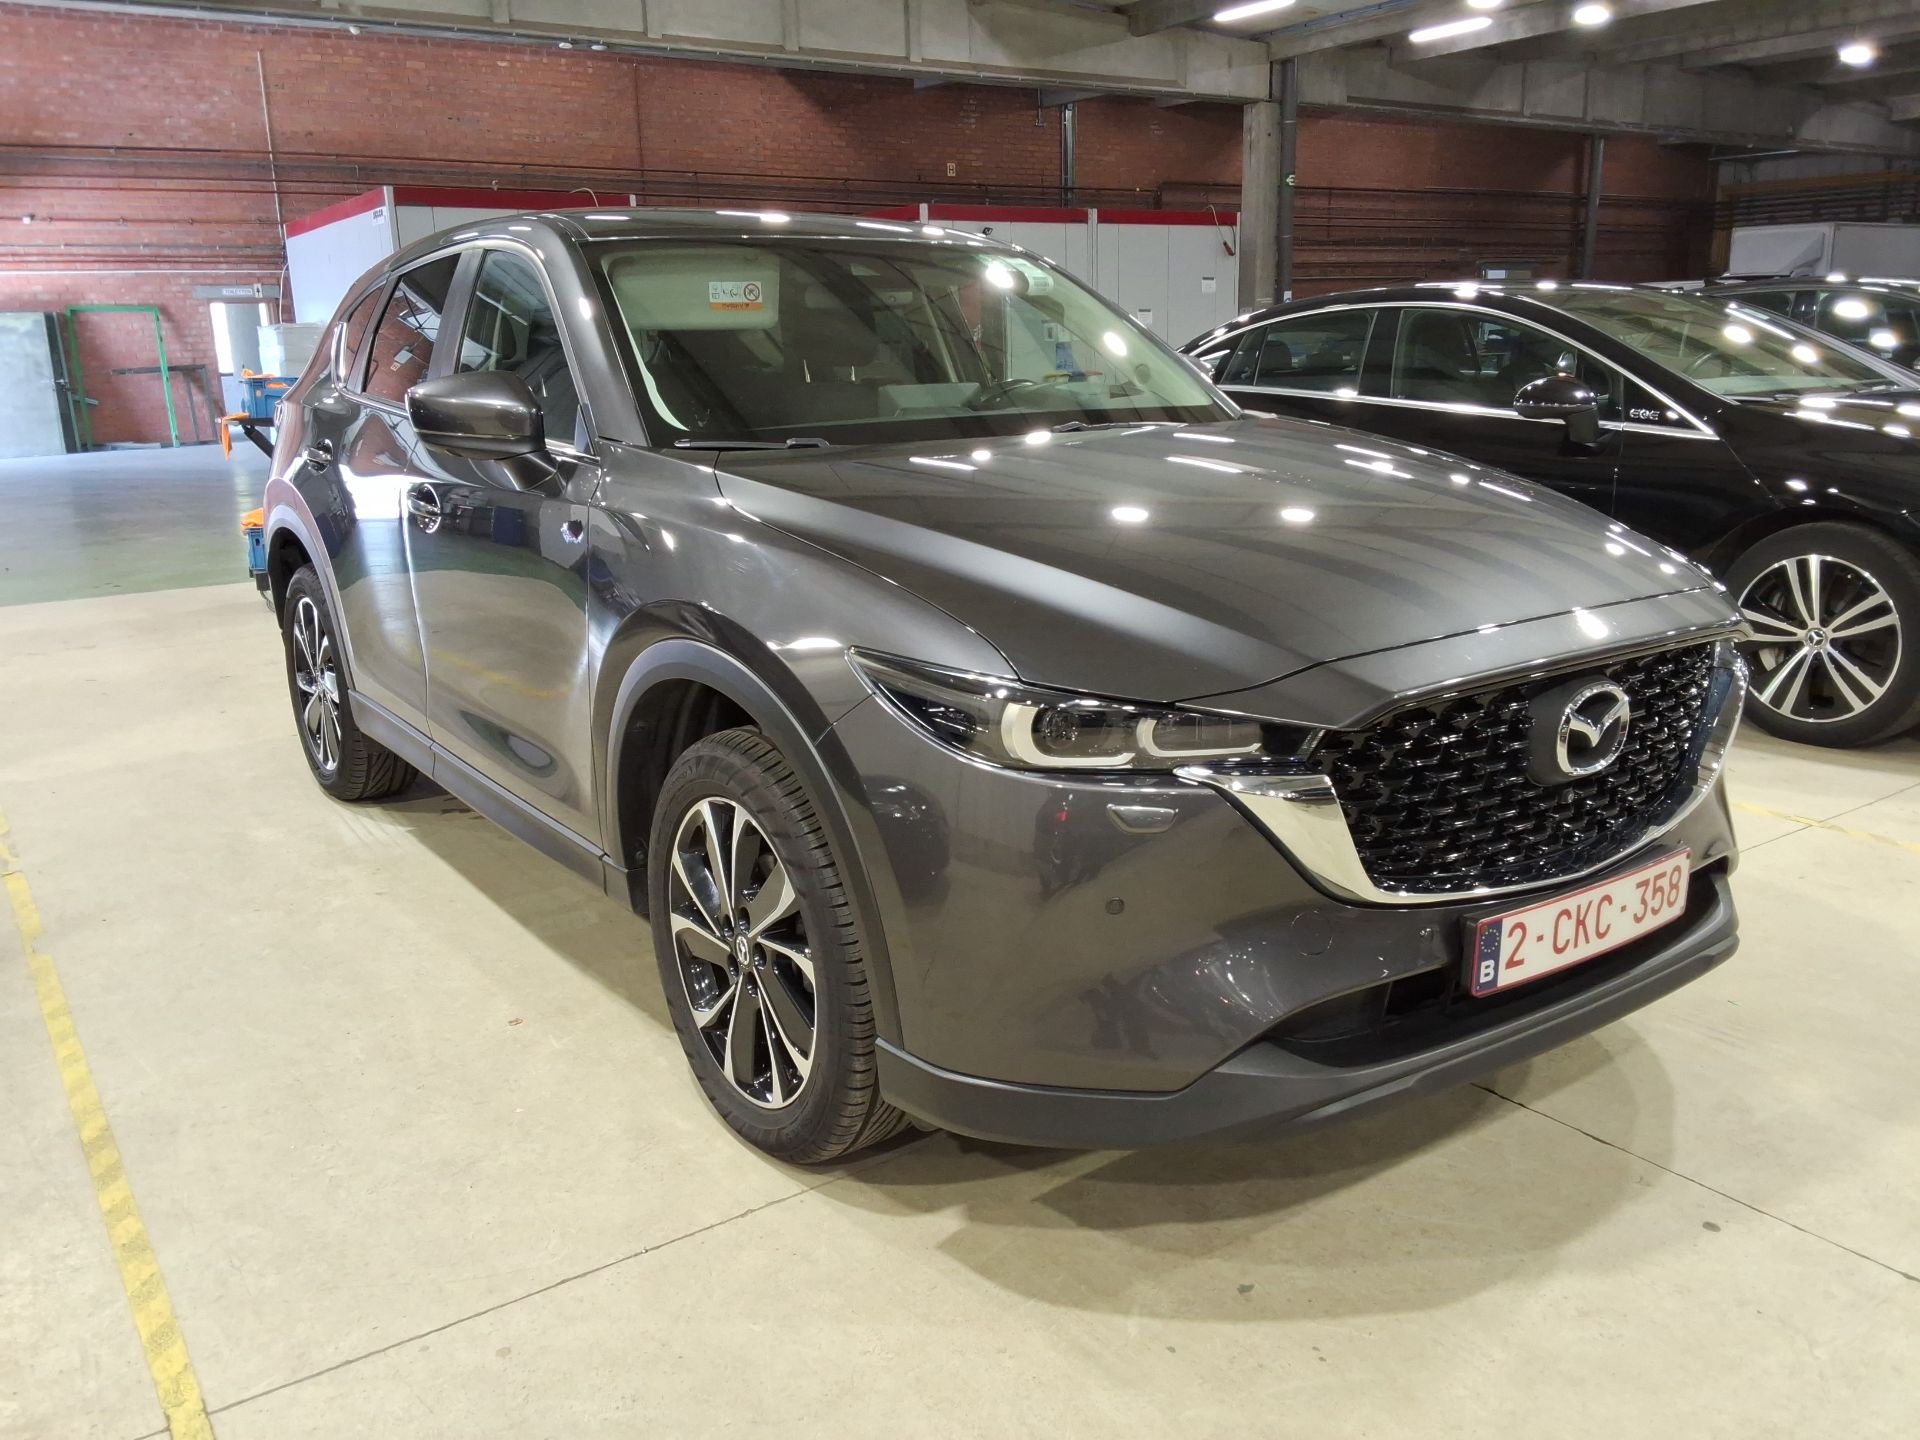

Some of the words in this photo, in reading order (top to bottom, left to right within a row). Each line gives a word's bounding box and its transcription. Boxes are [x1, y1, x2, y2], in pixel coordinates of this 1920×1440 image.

[1629, 408, 1660, 420] EQE
[1505, 864, 1682, 970] 2-CKC-358
[1479, 959, 1495, 983] B
